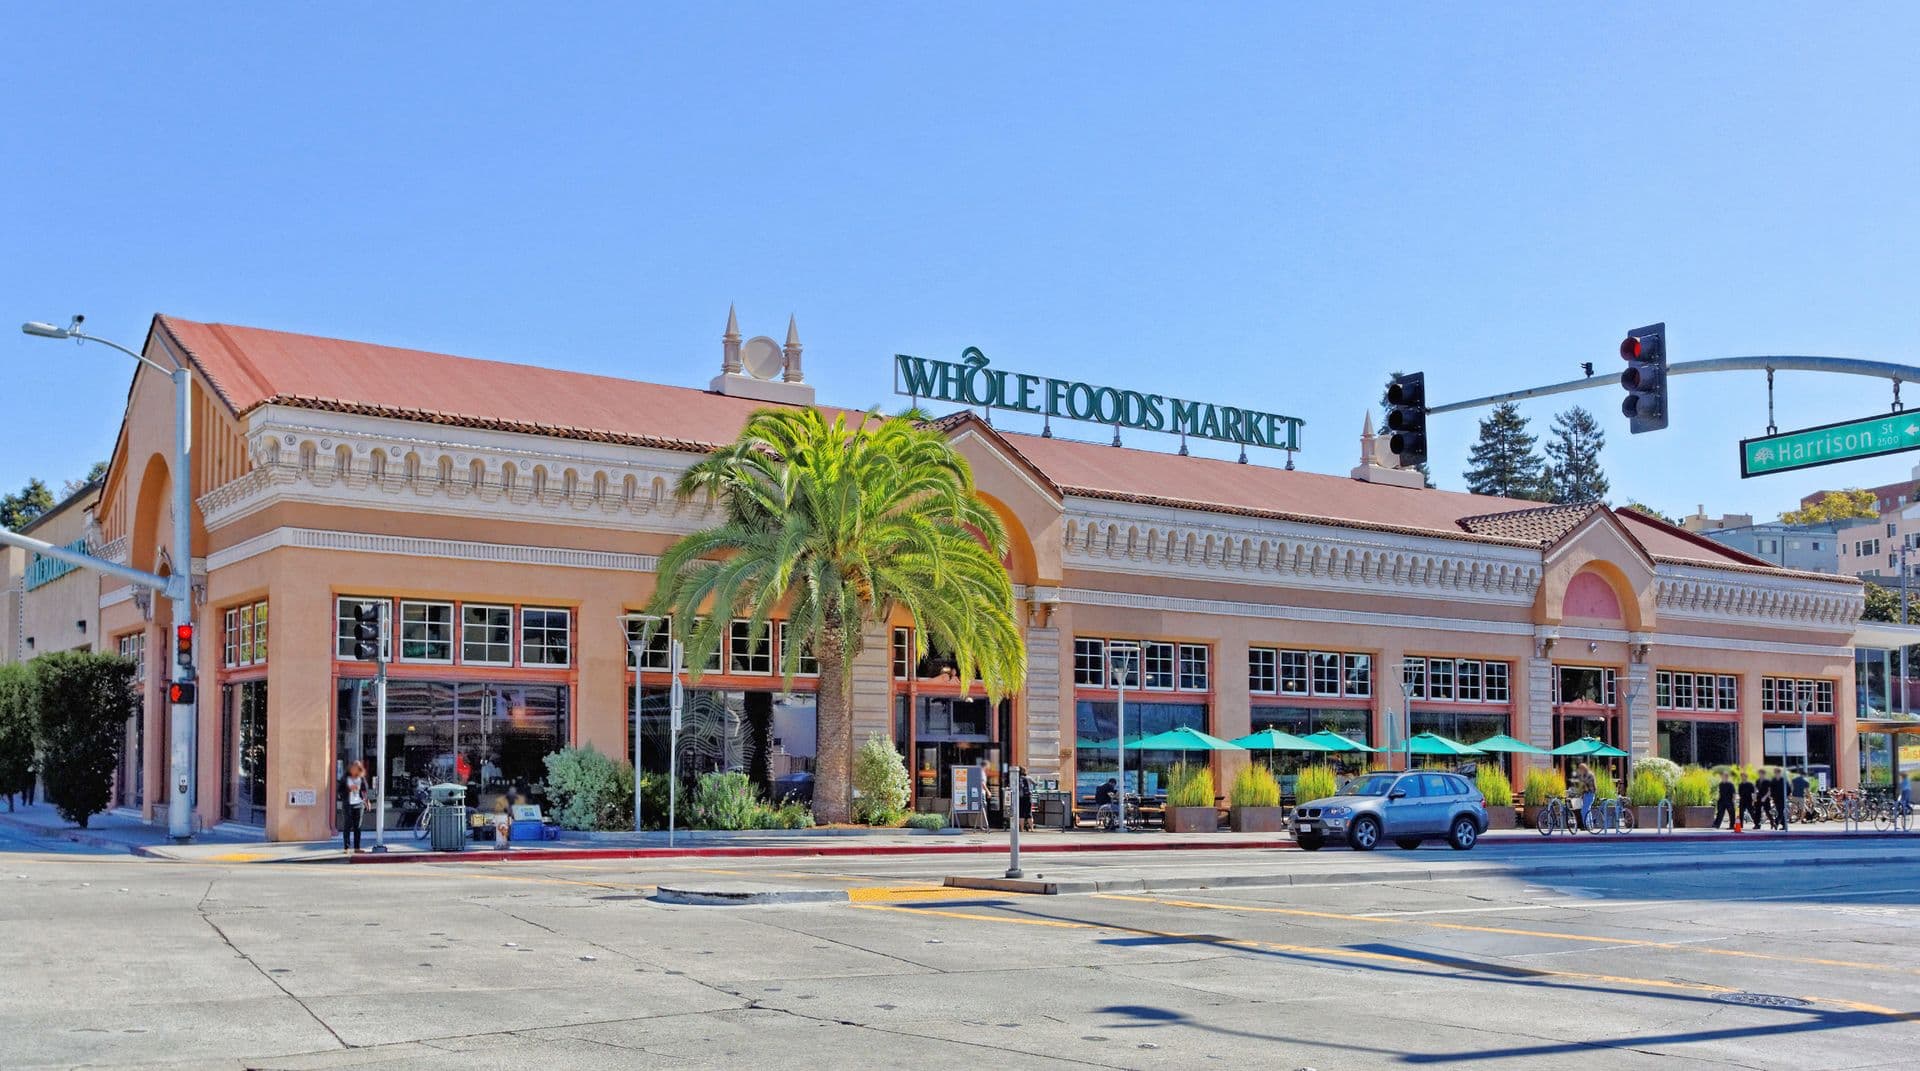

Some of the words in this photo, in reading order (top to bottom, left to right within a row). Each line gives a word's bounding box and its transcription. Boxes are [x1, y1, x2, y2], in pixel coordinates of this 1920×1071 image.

[896, 350, 1041, 413] WHOLE
[1047, 379, 1165, 431] FOODS
[1169, 398, 1305, 451] MARKET
[1778, 431, 1872, 462] Harrison
[1881, 423, 1893, 434] St
[1878, 435, 1899, 446] 2500
